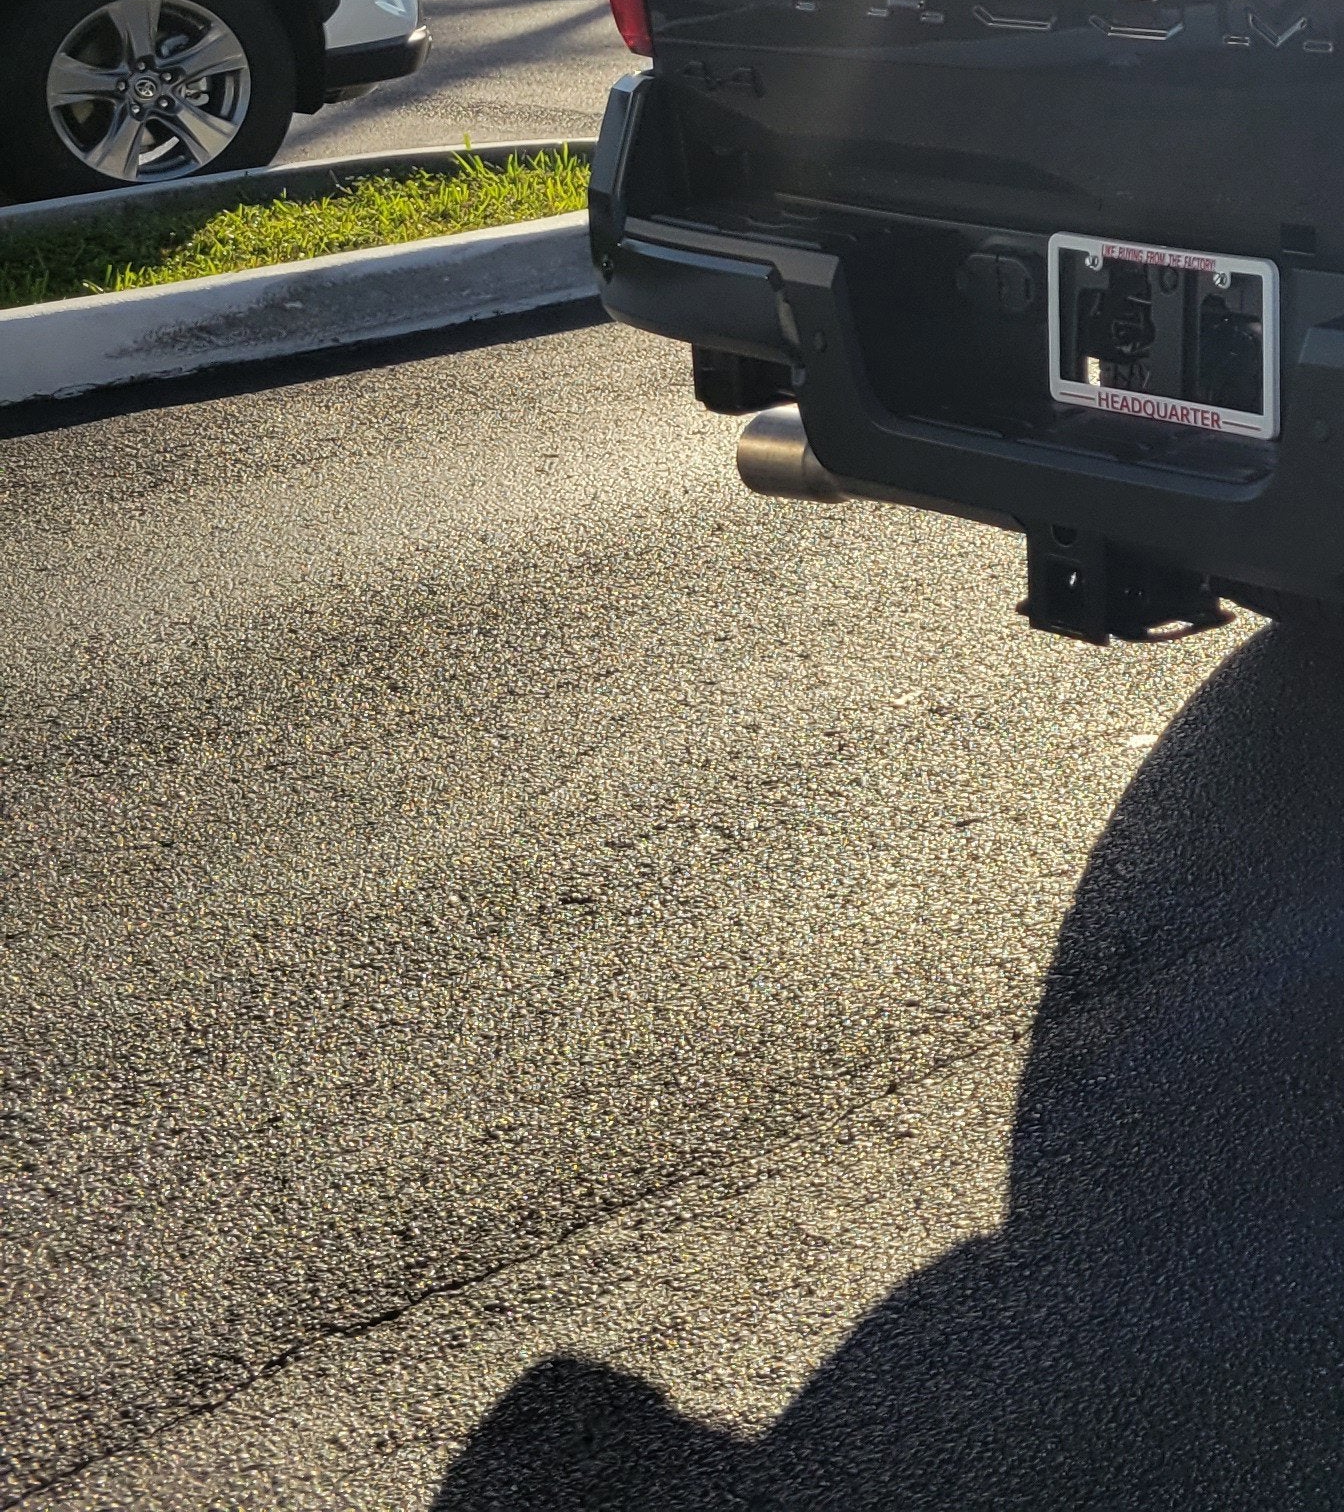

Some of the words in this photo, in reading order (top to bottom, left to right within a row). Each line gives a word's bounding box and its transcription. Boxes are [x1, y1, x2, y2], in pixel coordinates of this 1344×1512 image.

[1146, 251, 1165, 265] FROM
[1169, 254, 1181, 267] THE
[1097, 391, 1222, 430] HEADQUARTER
